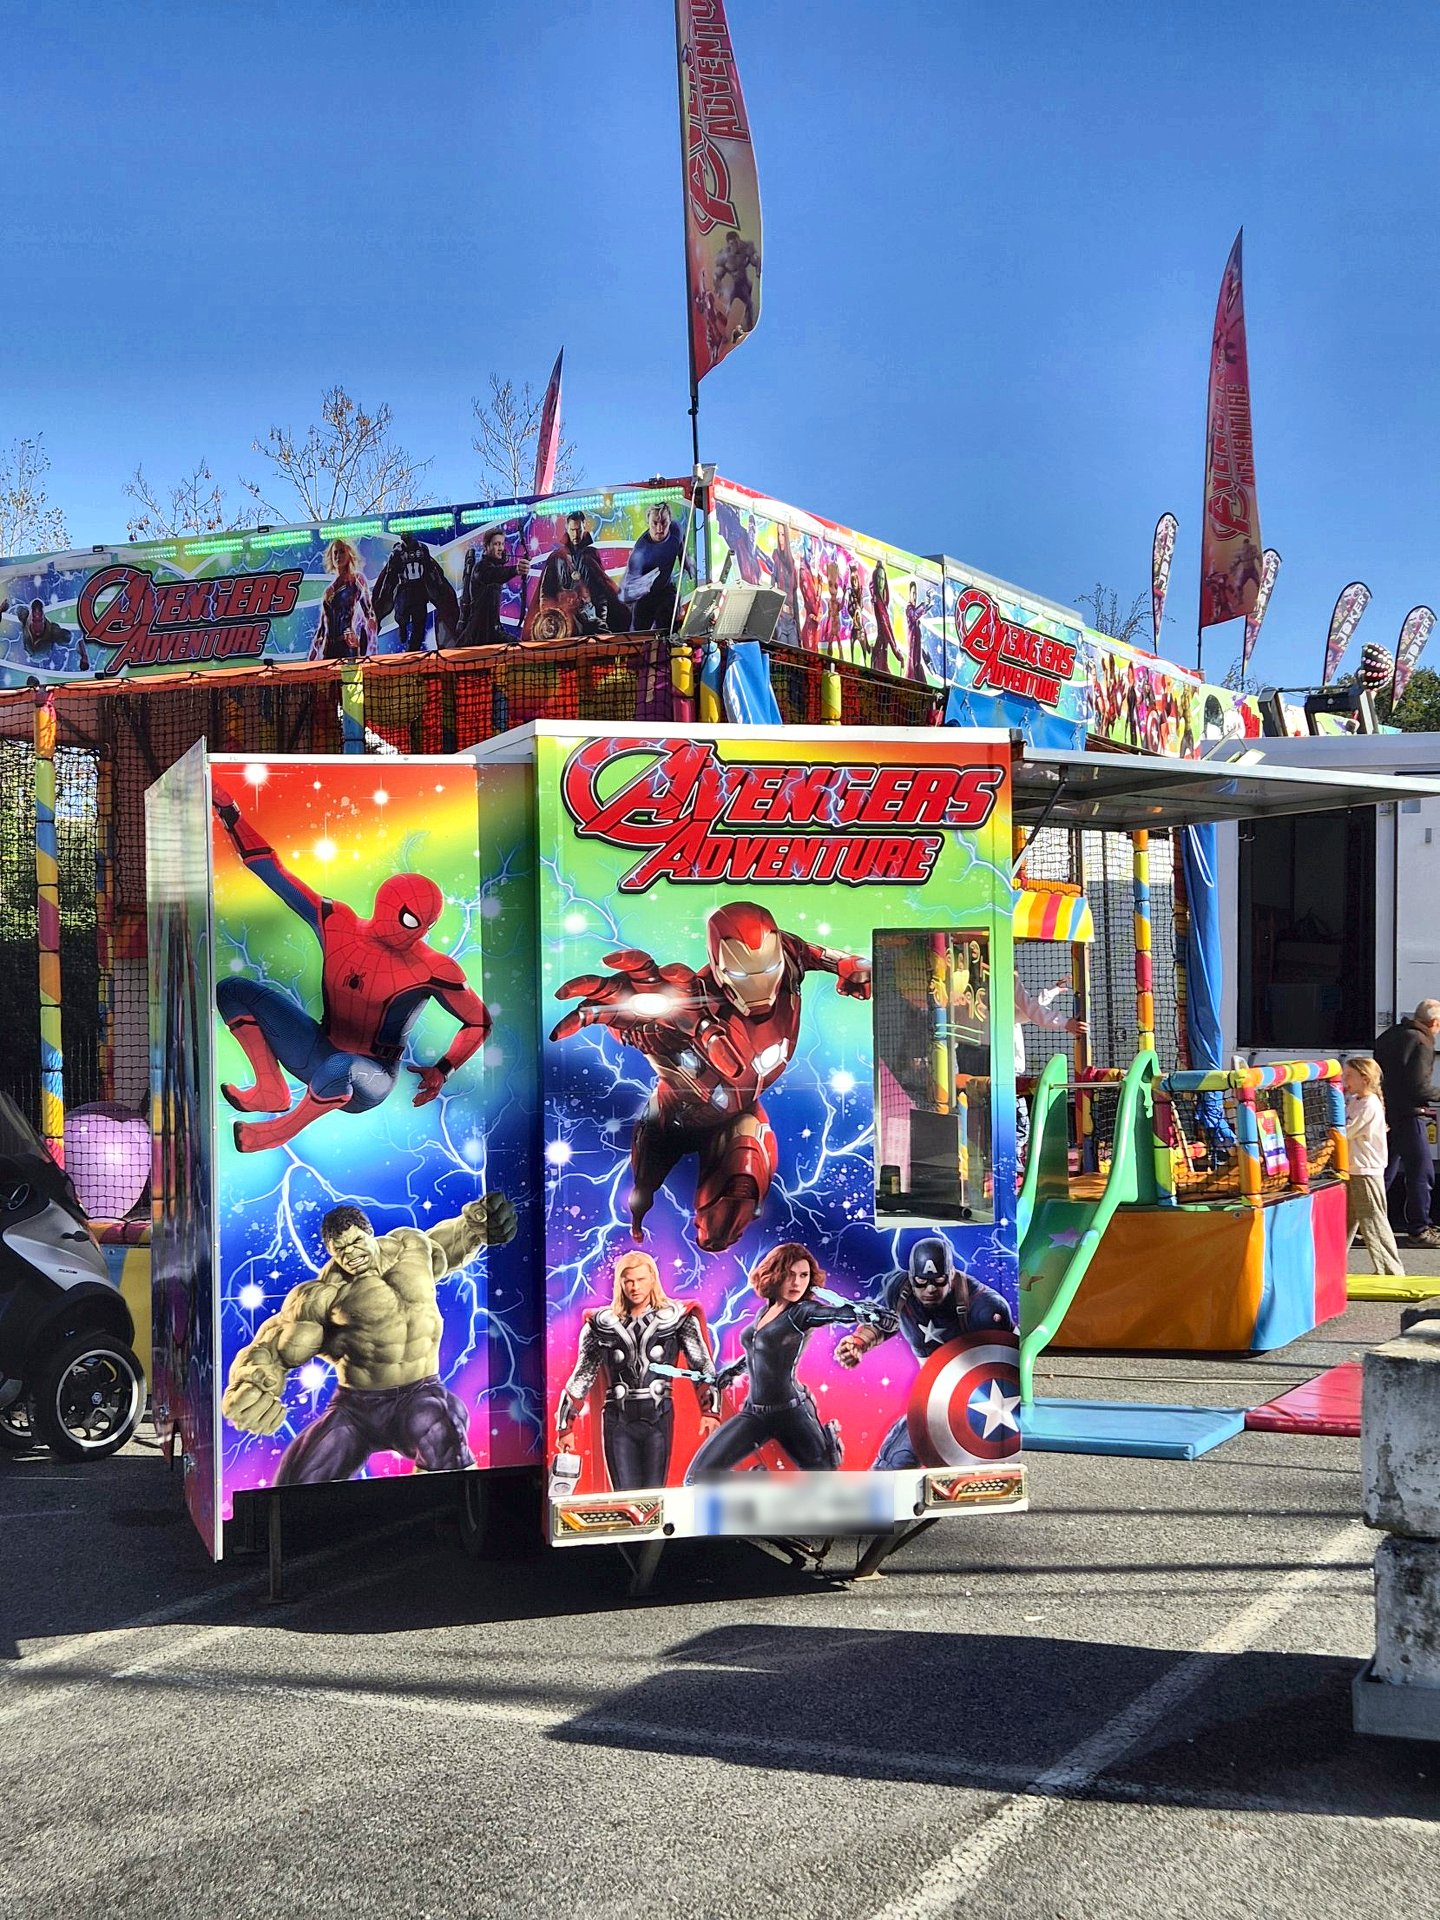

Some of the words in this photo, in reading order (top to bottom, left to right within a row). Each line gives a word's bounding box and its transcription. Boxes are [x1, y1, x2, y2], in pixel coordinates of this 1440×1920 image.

[691, 0, 750, 142] ADVENTU
[1225, 384, 1255, 487] ADVENTURE
[1158, 527, 1175, 589] JOKER
[79, 565, 303, 645] AVENGERS
[956, 588, 1077, 680] AVENGERS
[1336, 594, 1366, 646] JOKER
[106, 621, 269, 674] ADVENTURE
[1404, 619, 1432, 667] JOKER
[973, 651, 1061, 706] ADVENTURE
[564, 737, 1003, 846] AVENGERS
[621, 820, 945, 890] ADVENTURE
[922, 1259, 938, 1274] A
